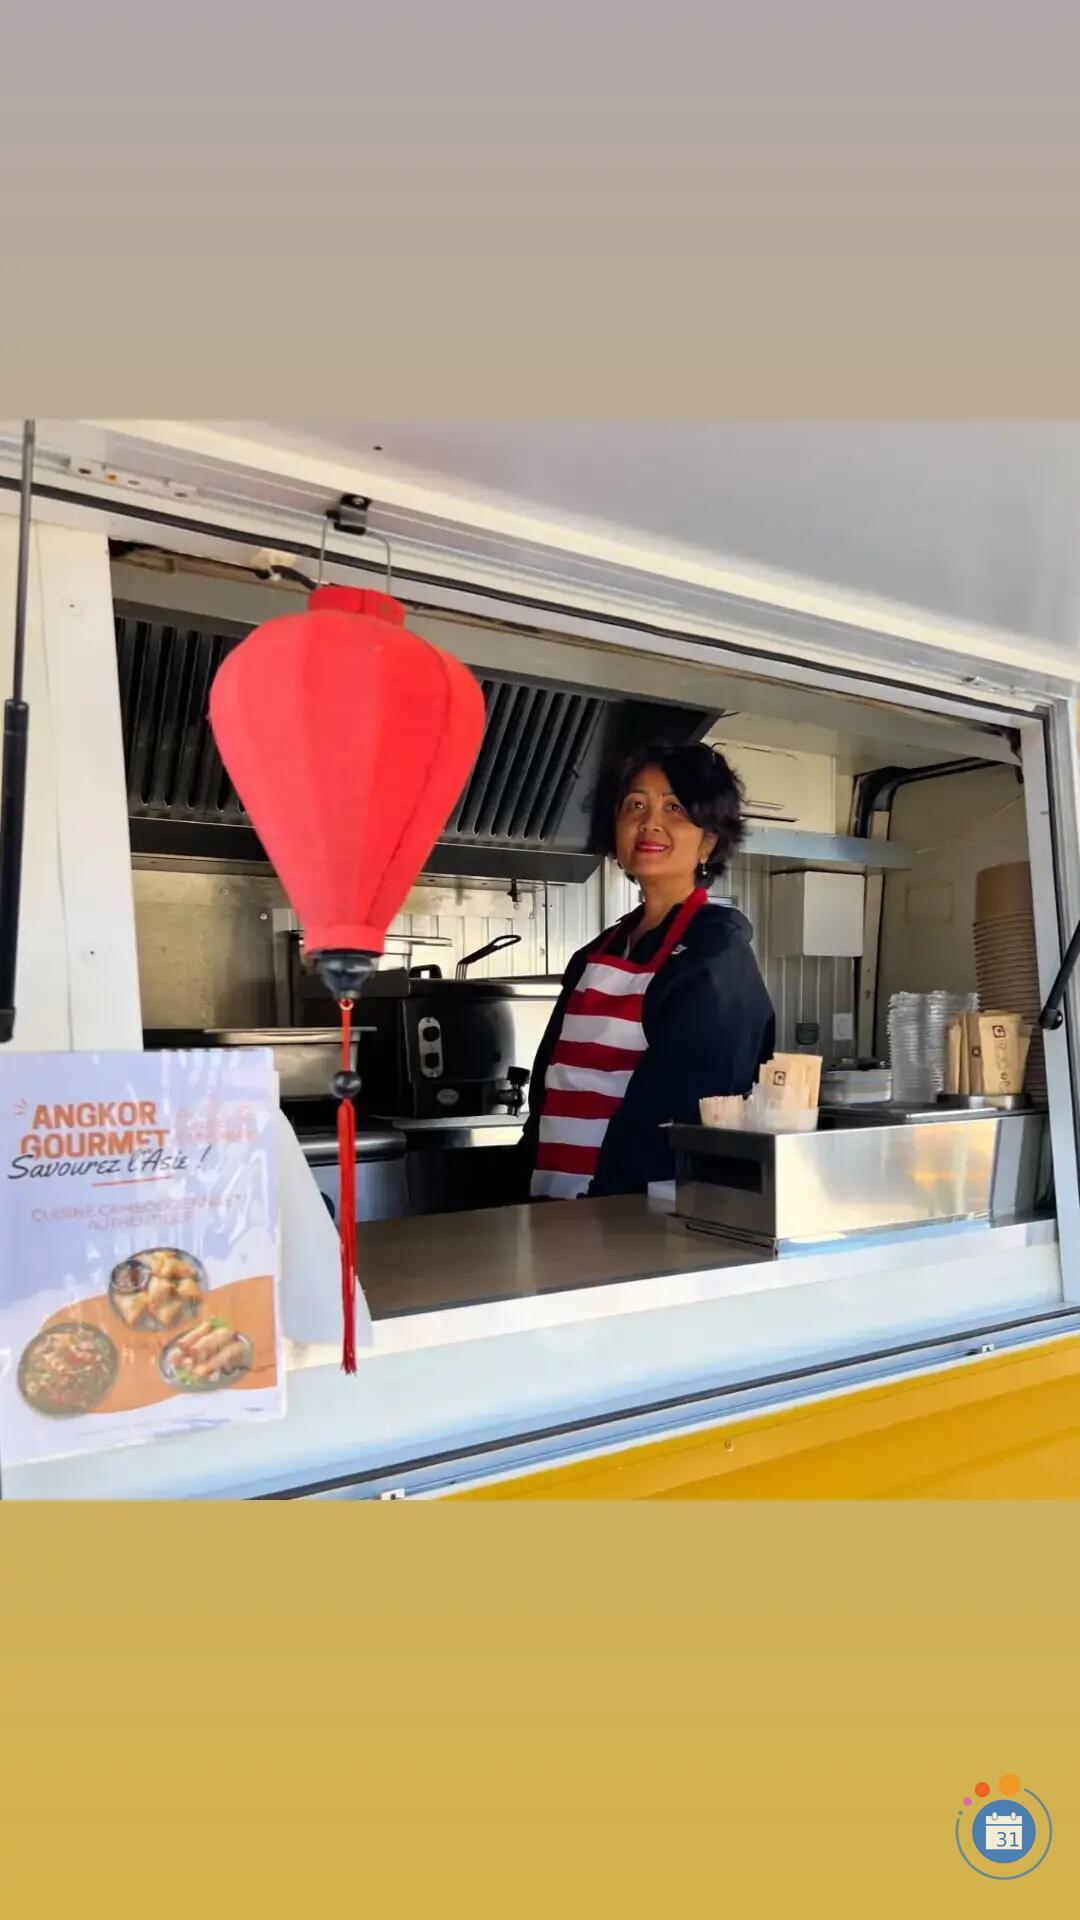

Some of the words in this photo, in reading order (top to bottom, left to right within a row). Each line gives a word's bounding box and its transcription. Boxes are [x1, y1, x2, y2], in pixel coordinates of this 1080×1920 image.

[32, 1101, 157, 1129] ANGKOR
[20, 1128, 170, 1160] GOURMET
[7, 1154, 120, 1180] Savourez
[127, 1147, 188, 1173] l'Asie
[88, 1208, 193, 1231] AUTHETQUE
[98, 1196, 222, 1216] CAMBODENNE
